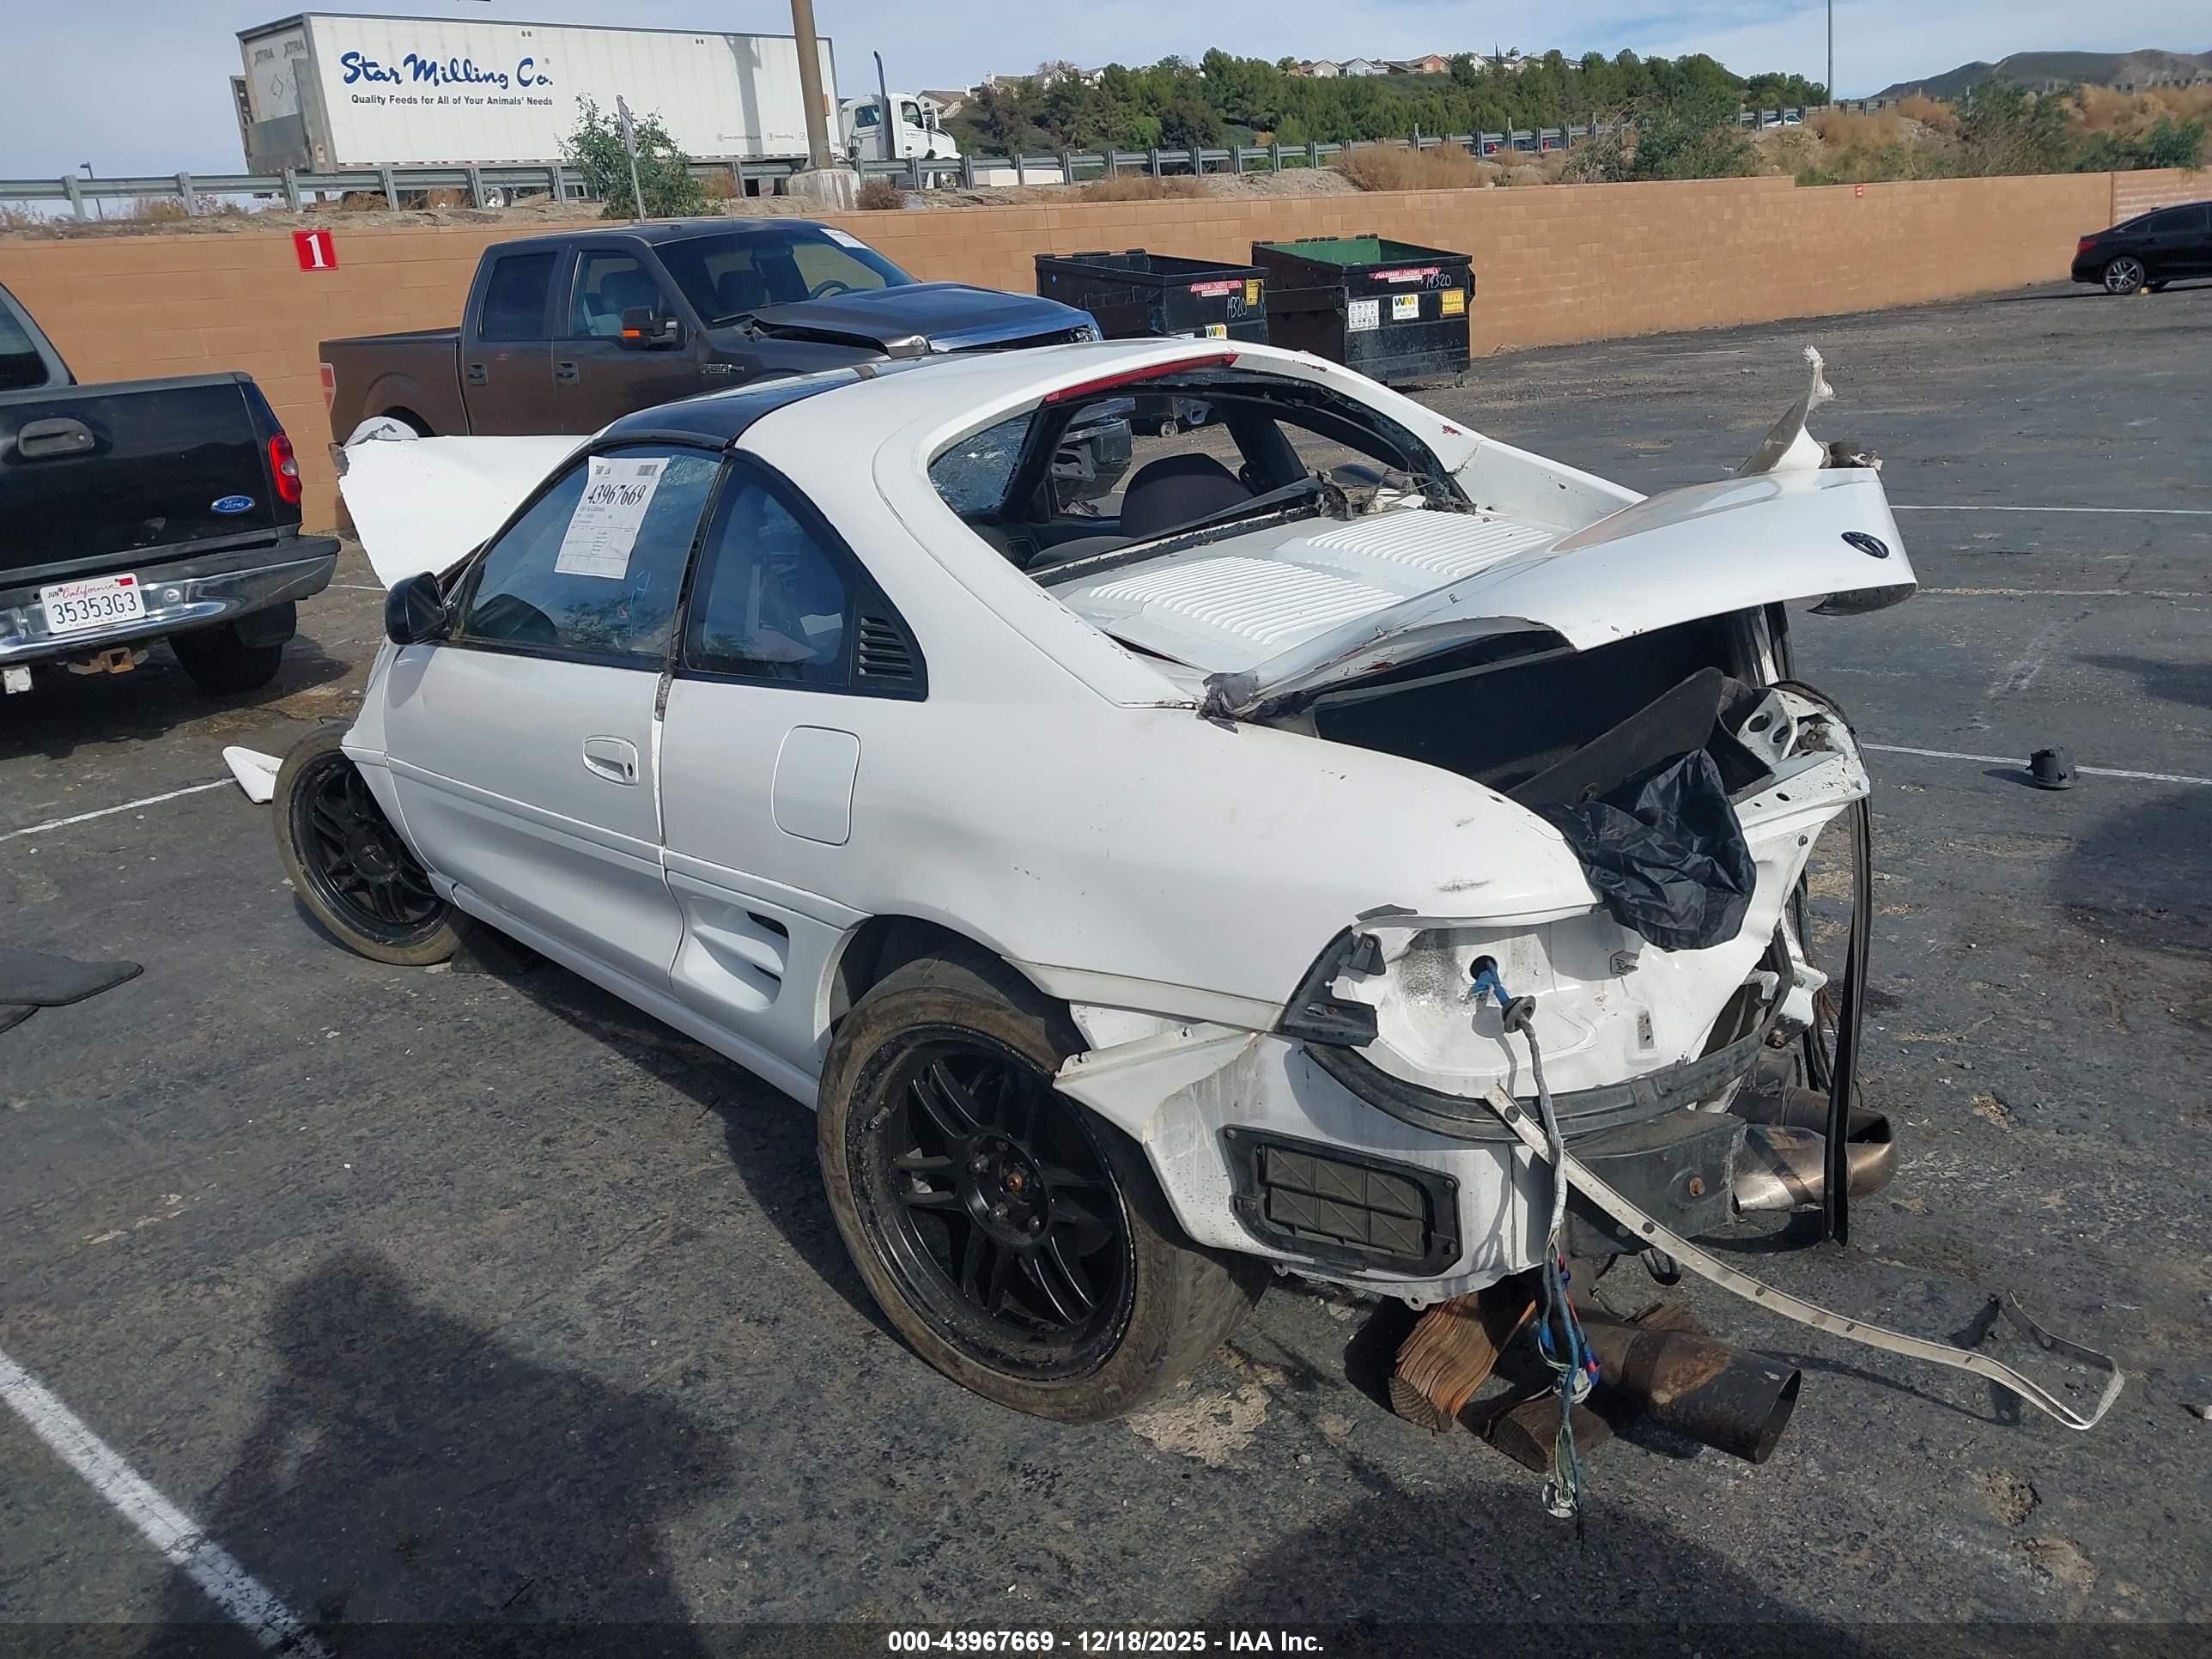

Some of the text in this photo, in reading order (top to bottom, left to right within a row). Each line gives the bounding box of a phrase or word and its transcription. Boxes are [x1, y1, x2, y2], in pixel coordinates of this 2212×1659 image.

[340, 51, 553, 89] Star Milling Co.
[351, 94, 386, 106] Quality
[389, 94, 418, 105] Feeds
[421, 95, 434, 105] for
[437, 95, 450, 105] All
[453, 95, 461, 105] of
[464, 95, 484, 105] Your
[526, 96, 553, 106] Needs
[305, 233, 329, 268] 1
[1394, 296, 1415, 307] WM
[1207, 326, 1224, 337] WM
[587, 483, 647, 506] 43967669
[62, 584, 116, 599] California
[52, 592, 137, 624] 35353G3
